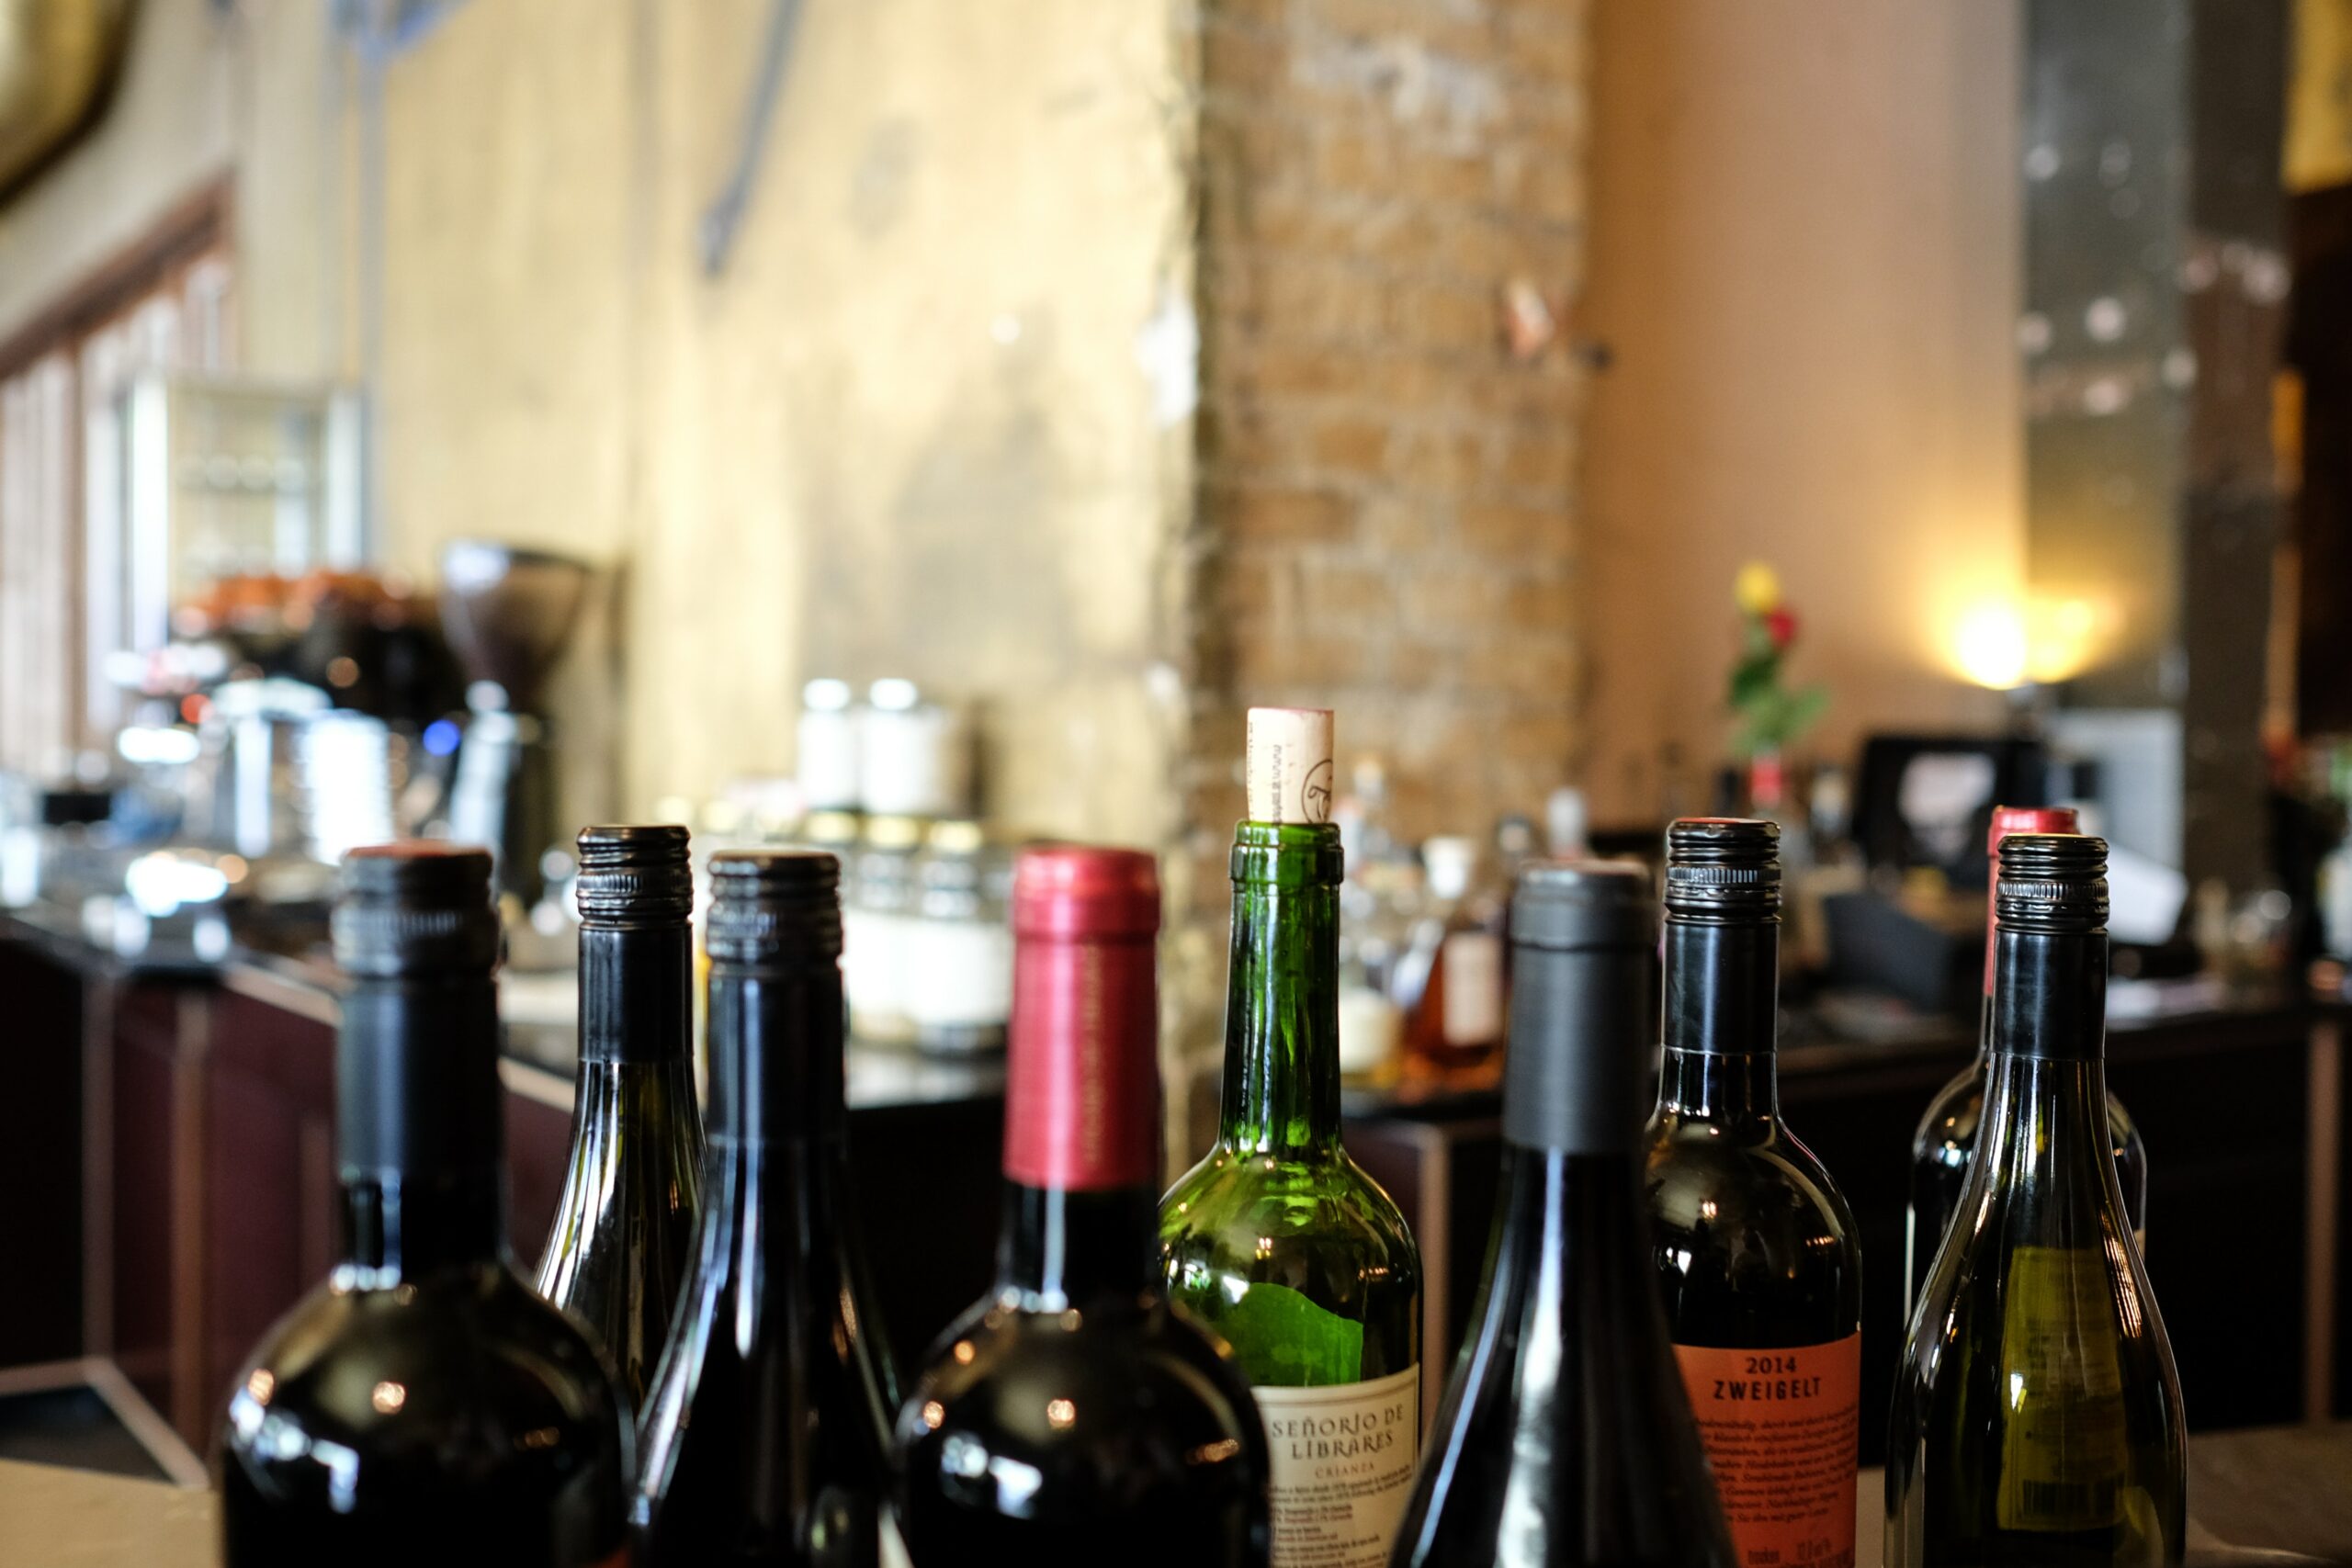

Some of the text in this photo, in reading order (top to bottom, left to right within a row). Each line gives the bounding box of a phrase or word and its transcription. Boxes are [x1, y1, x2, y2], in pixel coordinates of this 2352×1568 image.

[1747, 1357, 1797, 1375] 2014
[1713, 1377, 1821, 1401] ZWEIGELT
[1385, 1403, 1404, 1425] DE
[1291, 1430, 1394, 1461] LIBRARES
